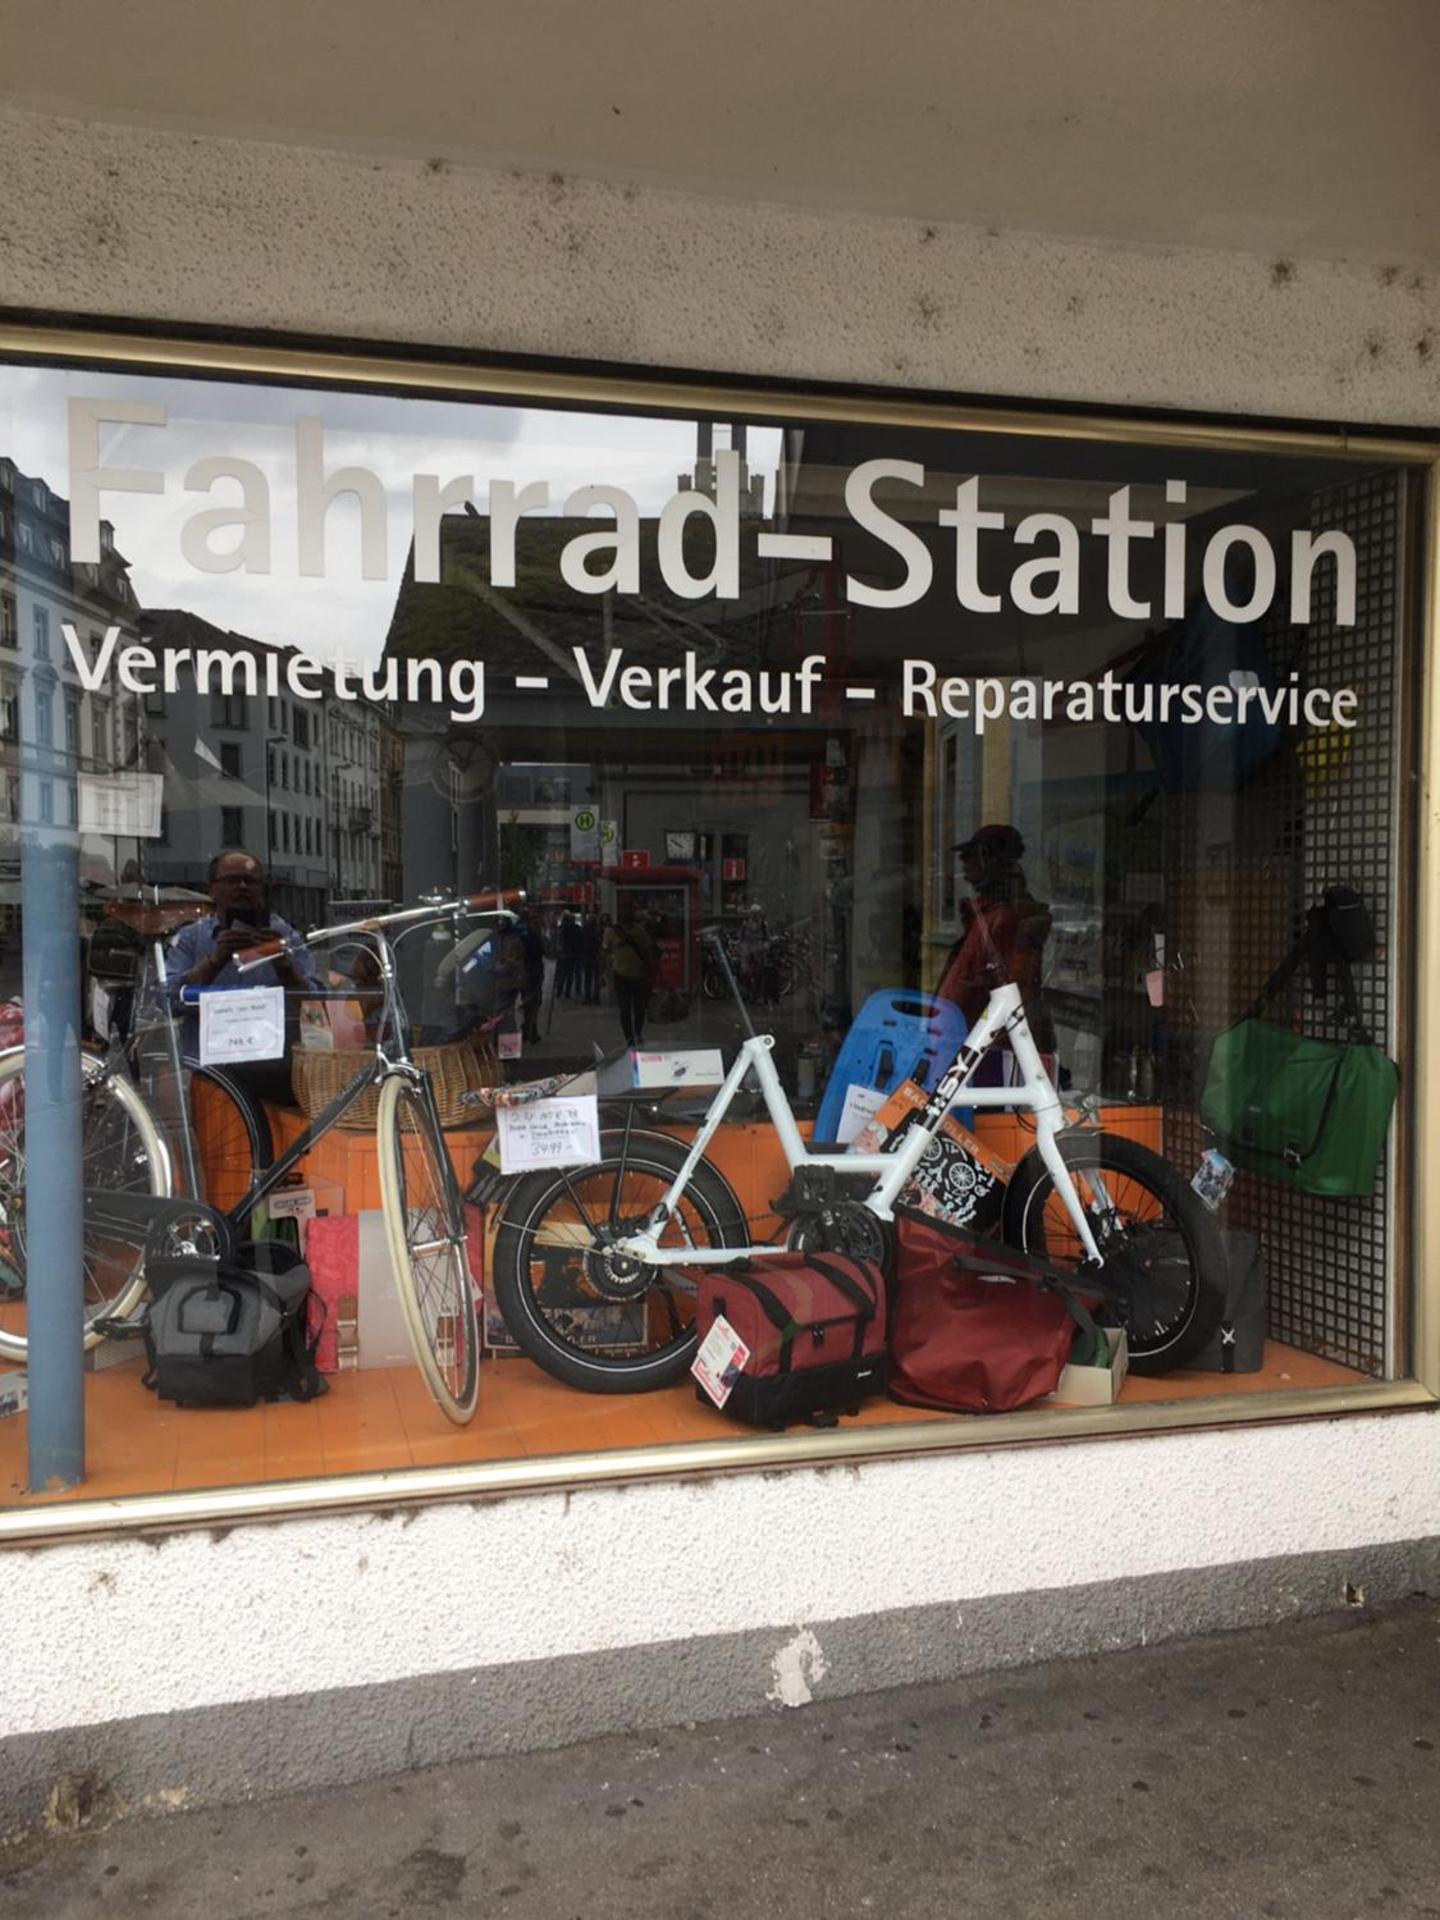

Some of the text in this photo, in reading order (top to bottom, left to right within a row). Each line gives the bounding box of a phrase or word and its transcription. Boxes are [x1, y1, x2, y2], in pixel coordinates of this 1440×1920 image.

[67, 397, 1358, 627] Fahrrad-Station
[62, 624, 486, 722] Vermietung
[573, 646, 827, 714] Verkauf
[902, 659, 1359, 735] Reparaturservice
